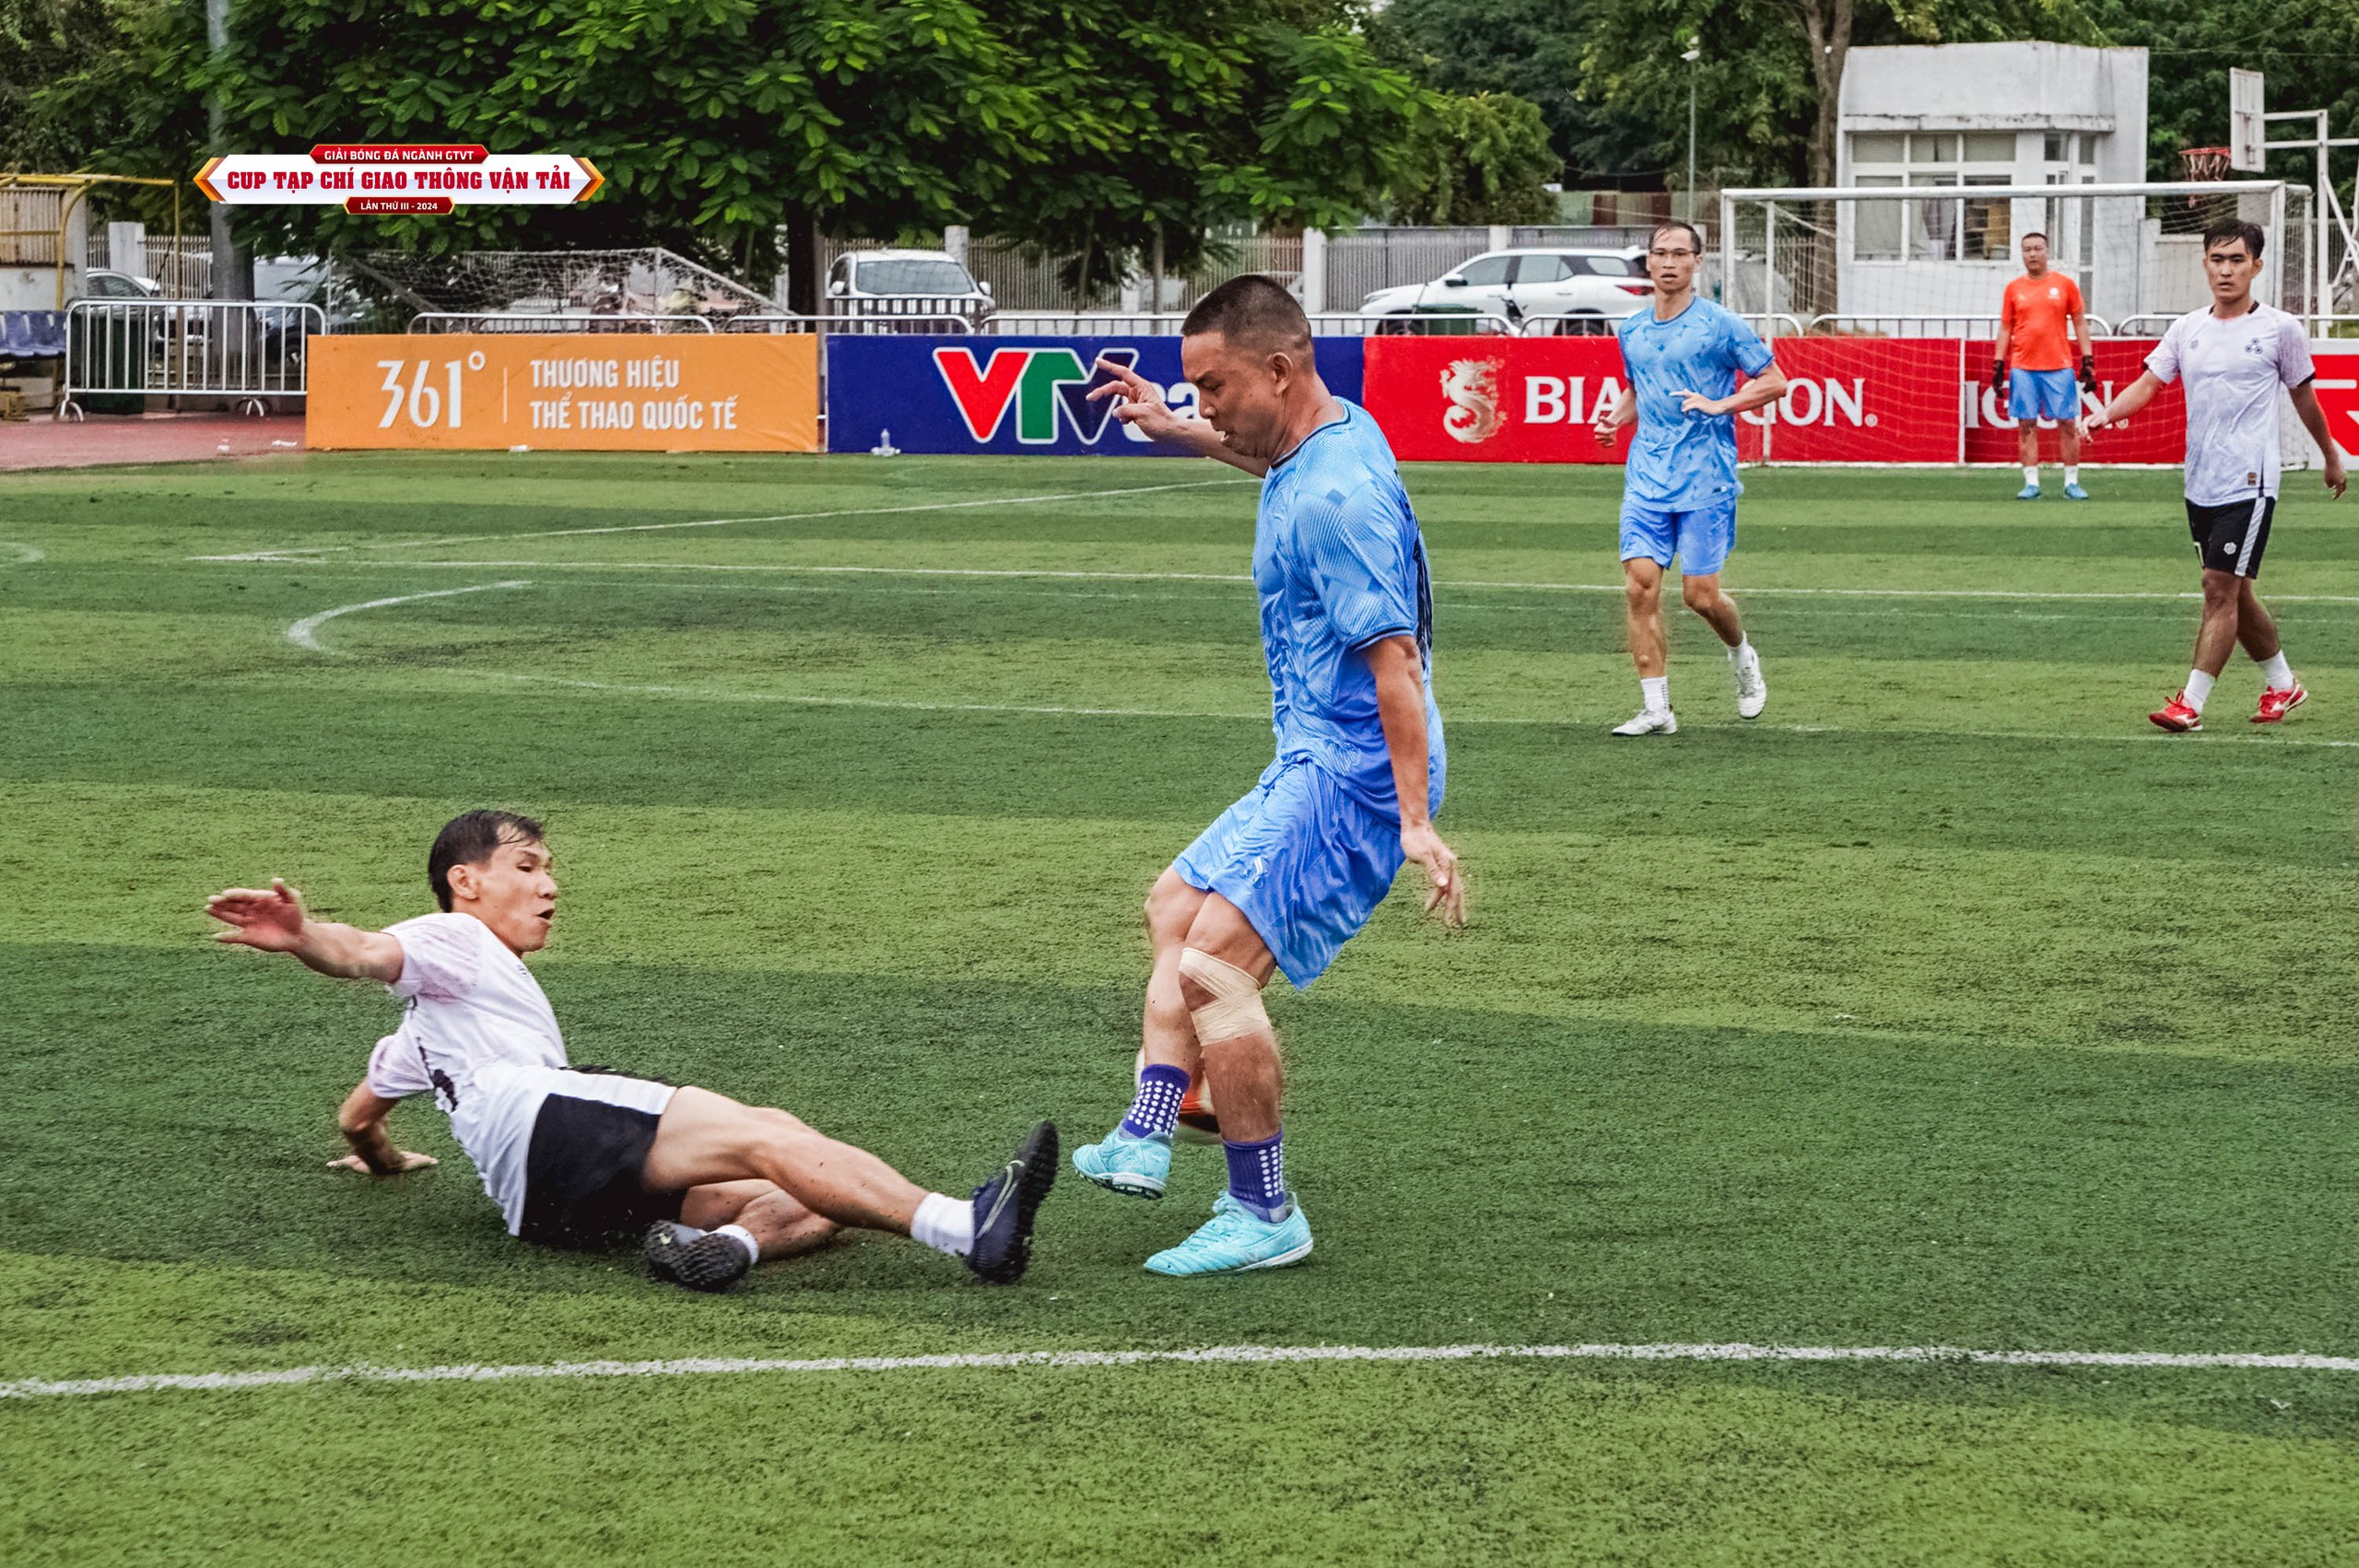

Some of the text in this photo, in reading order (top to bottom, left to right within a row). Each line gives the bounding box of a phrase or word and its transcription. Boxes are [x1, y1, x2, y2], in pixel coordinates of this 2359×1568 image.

[529, 355, 680, 390] THƯƠNG HIỆU
[530, 392, 738, 431] THỂ THAO QUỐC TẾ
[1523, 376, 1623, 425] BIA
